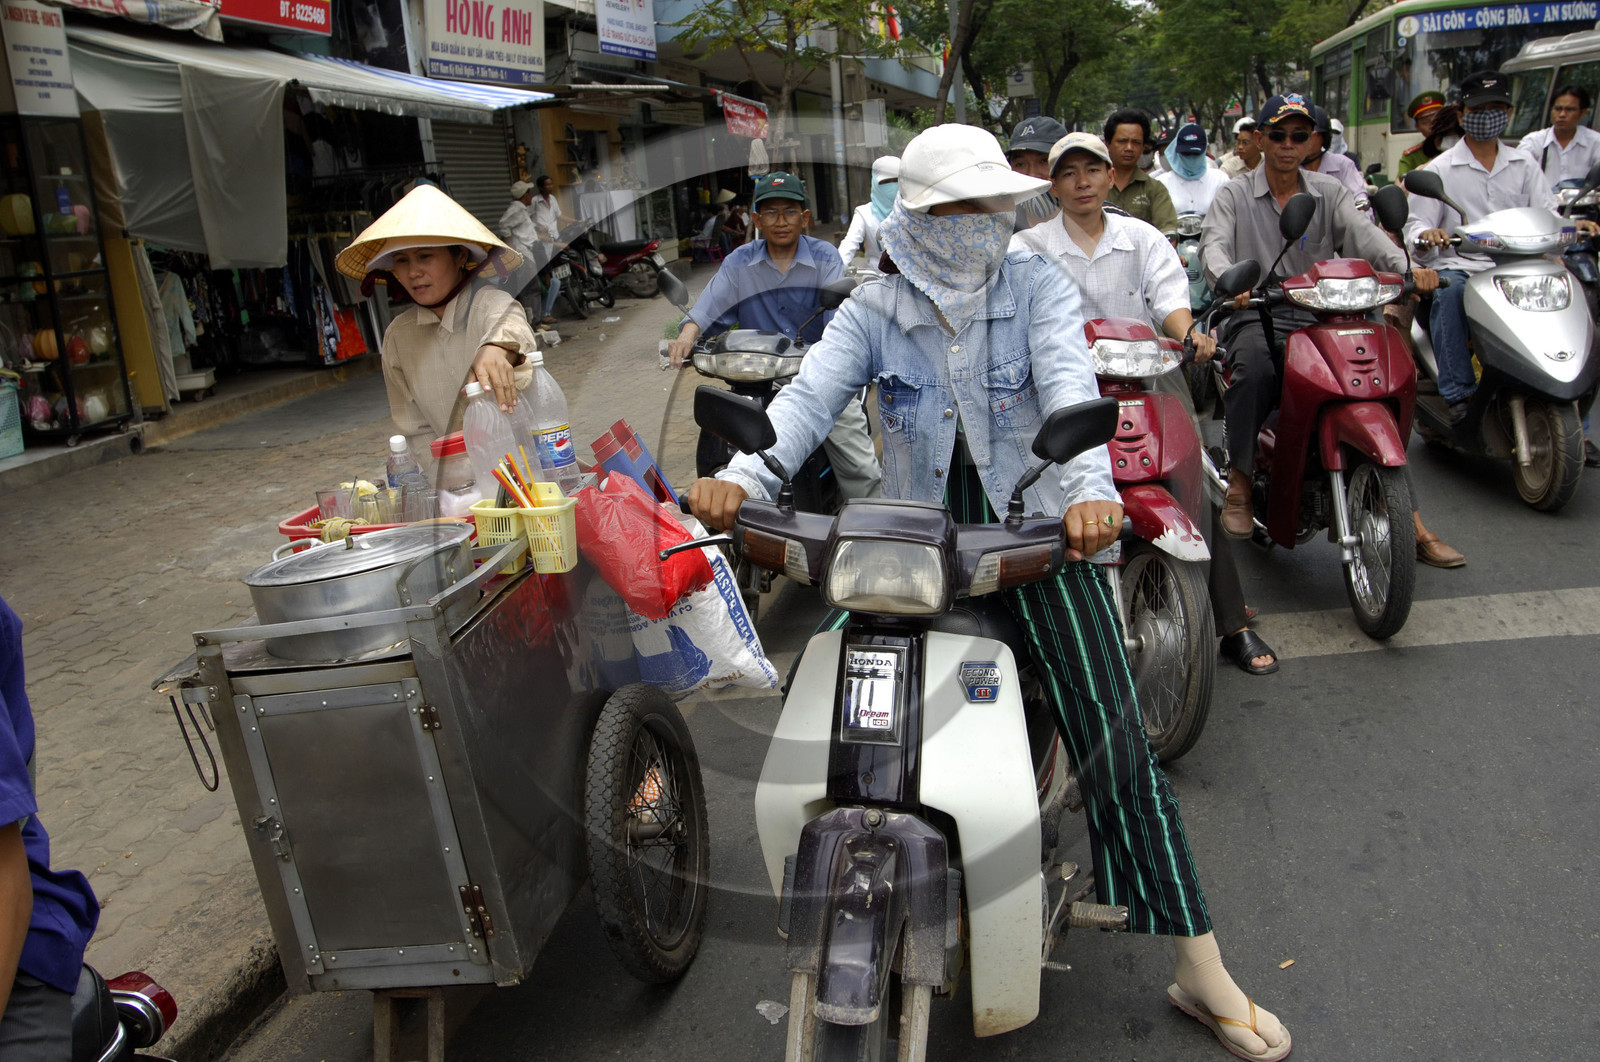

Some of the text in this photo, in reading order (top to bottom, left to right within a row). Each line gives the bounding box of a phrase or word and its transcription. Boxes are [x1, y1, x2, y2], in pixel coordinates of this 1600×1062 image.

[296, 3, 326, 25] 8225468
[1422, 13, 1441, 33] SÀI
[1443, 9, 1466, 31] GÒN
[1475, 7, 1505, 29] CỘNG
[1506, 5, 1530, 25] HÒA
[1543, 5, 1559, 22] AN
[502, 7, 532, 46] ANH
[1402, 19, 1413, 34] 4
[539, 429, 571, 444] PEPS
[678, 604, 693, 615] CJ
[849, 658, 893, 667] HONDA
[969, 677, 1000, 685] POWER
[859, 709, 890, 718] Dream
